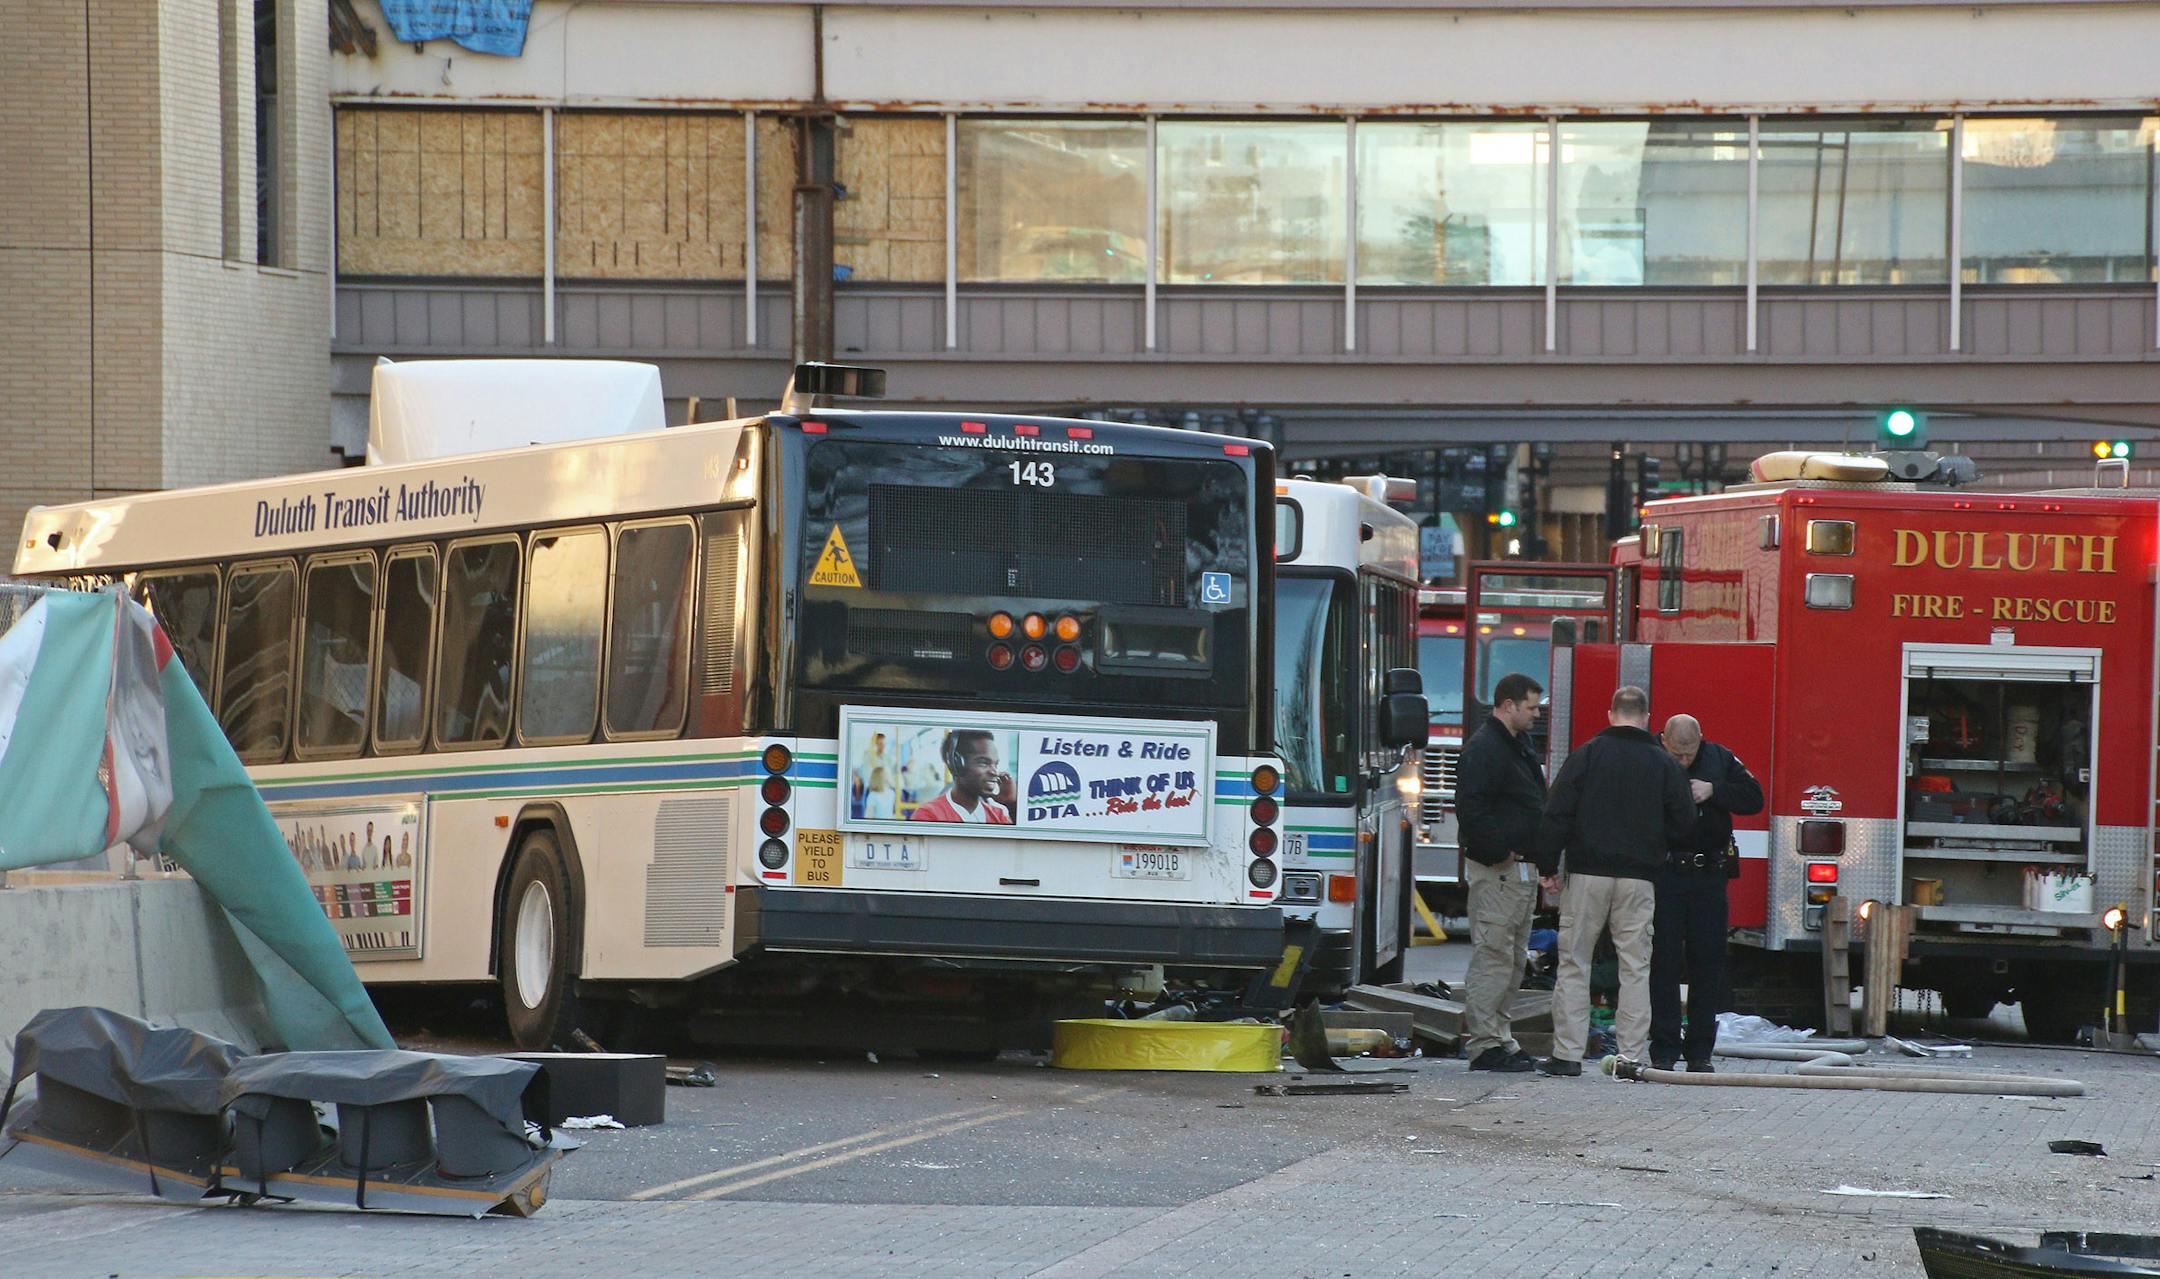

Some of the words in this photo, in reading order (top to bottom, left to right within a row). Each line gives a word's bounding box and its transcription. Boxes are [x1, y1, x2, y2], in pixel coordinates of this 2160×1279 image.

[938, 434, 1114, 455] www.duluthtransit.com
[1008, 460, 1056, 488] 143
[254, 495, 317, 538] Duluth
[324, 486, 391, 530] Transit
[395, 476, 487, 524] Authority
[1891, 528, 2119, 574] DULUTH
[815, 571, 856, 584] CAUTION
[1891, 594, 1965, 619] FIRE
[1992, 597, 2117, 624] RESCUE
[1040, 737, 1110, 757] Listen
[1117, 741, 1134, 758] &
[1141, 742, 1191, 761] Ride
[1089, 776, 1143, 800] THINK
[1147, 773, 1171, 793] OF
[1028, 804, 1081, 822] DTA
[798, 833, 841, 845] PLEASE
[804, 846, 835, 857] YIELD
[811, 858, 826, 869] TO
[1135, 853, 1179, 871] 19901B
[807, 871, 830, 881] BUS
